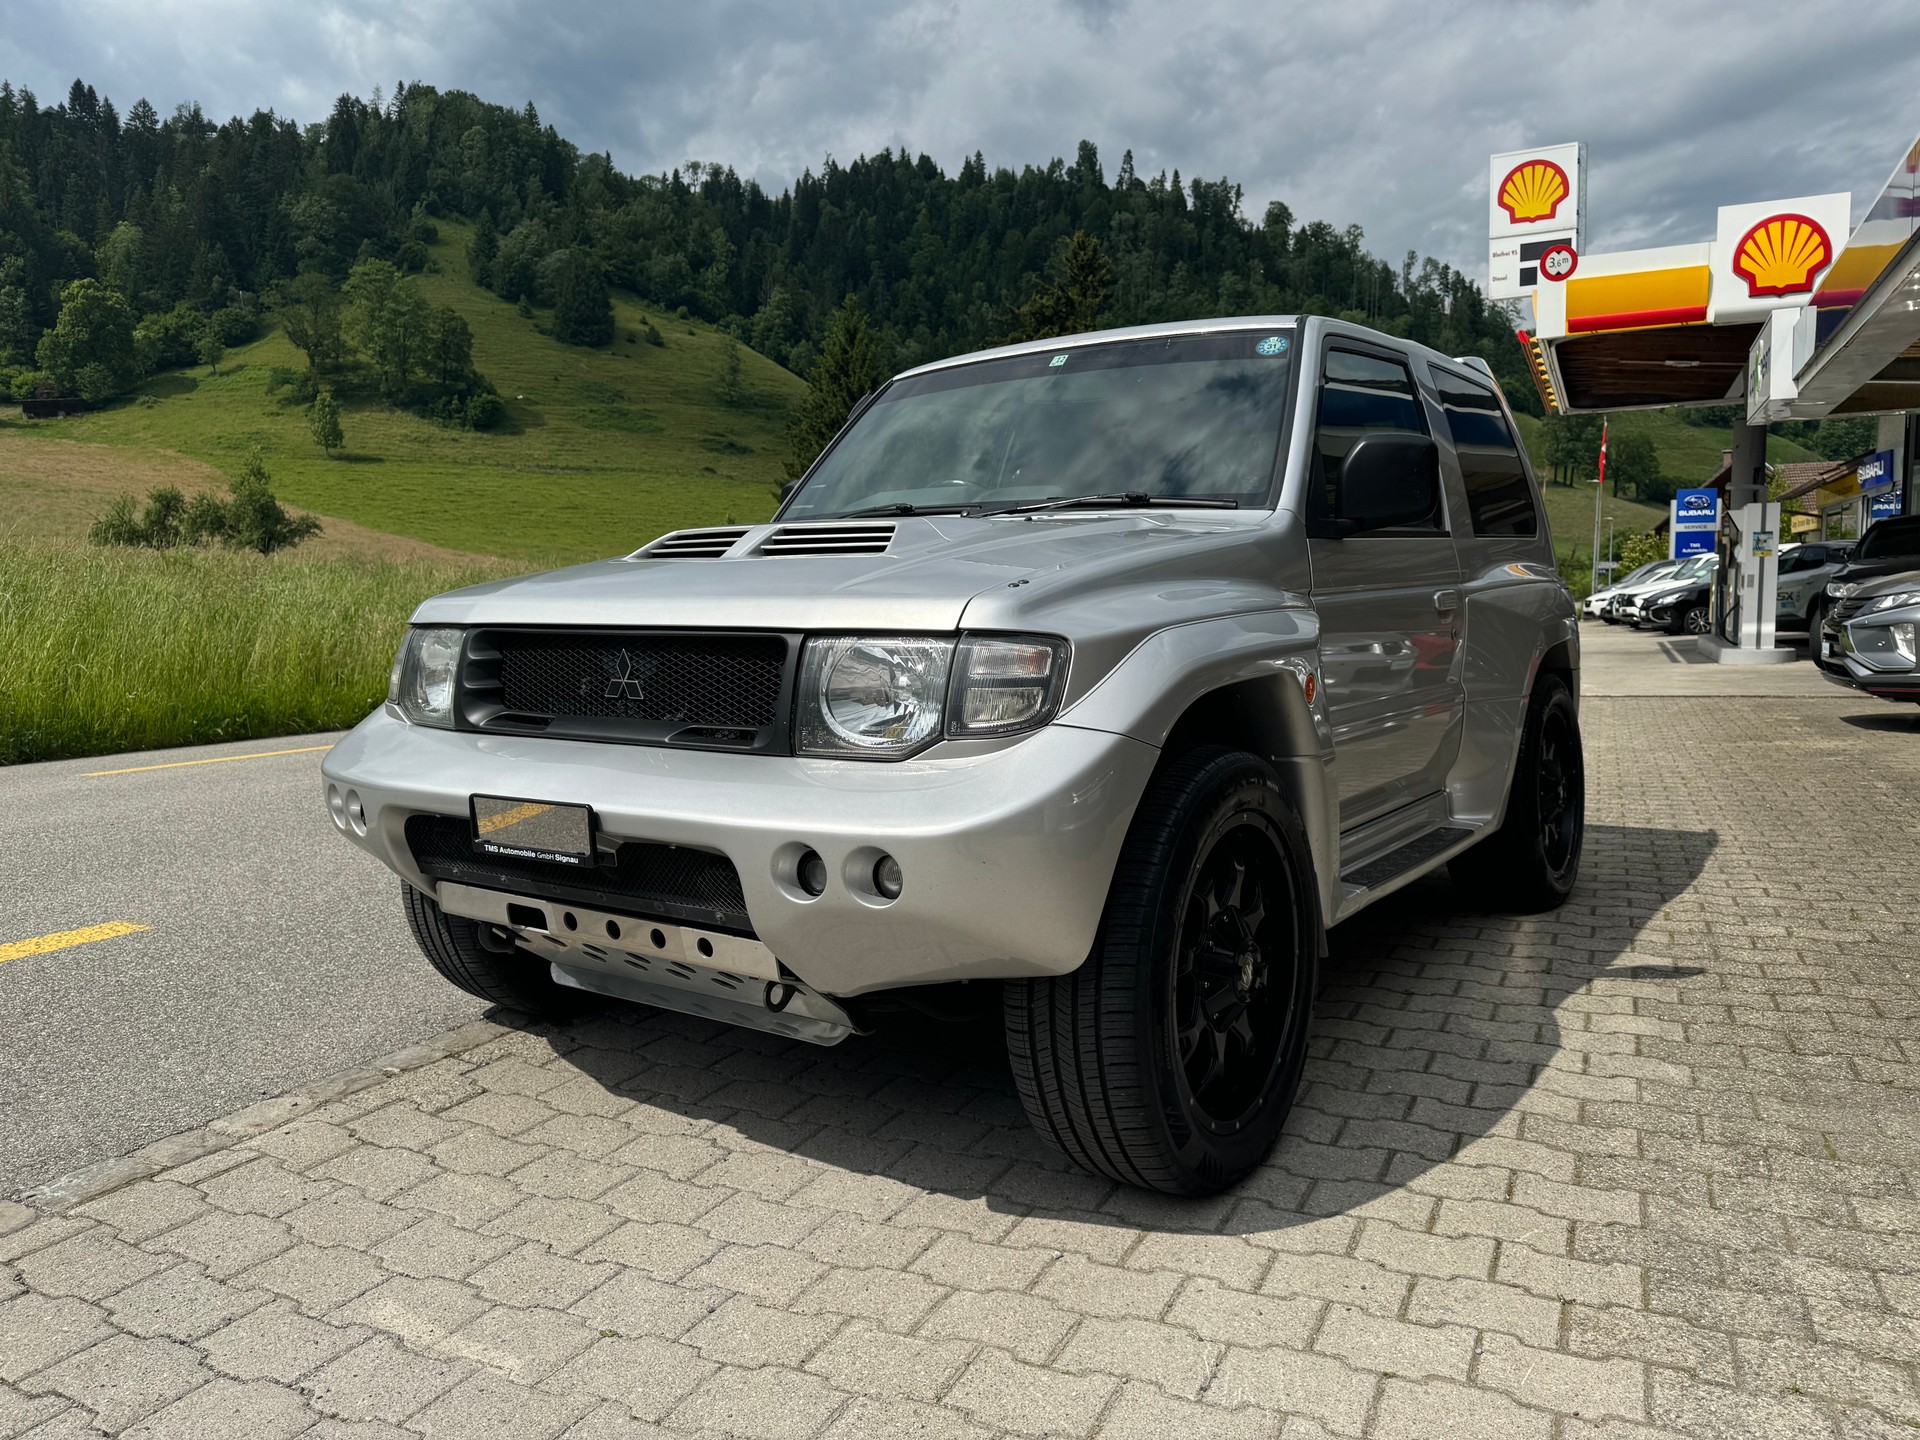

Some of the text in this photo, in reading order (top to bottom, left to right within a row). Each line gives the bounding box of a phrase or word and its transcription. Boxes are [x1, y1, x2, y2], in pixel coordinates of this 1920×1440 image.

[1678, 509, 1715, 517] SUBARU
[484, 844, 579, 864] TMS Automobile GmbH Signau
